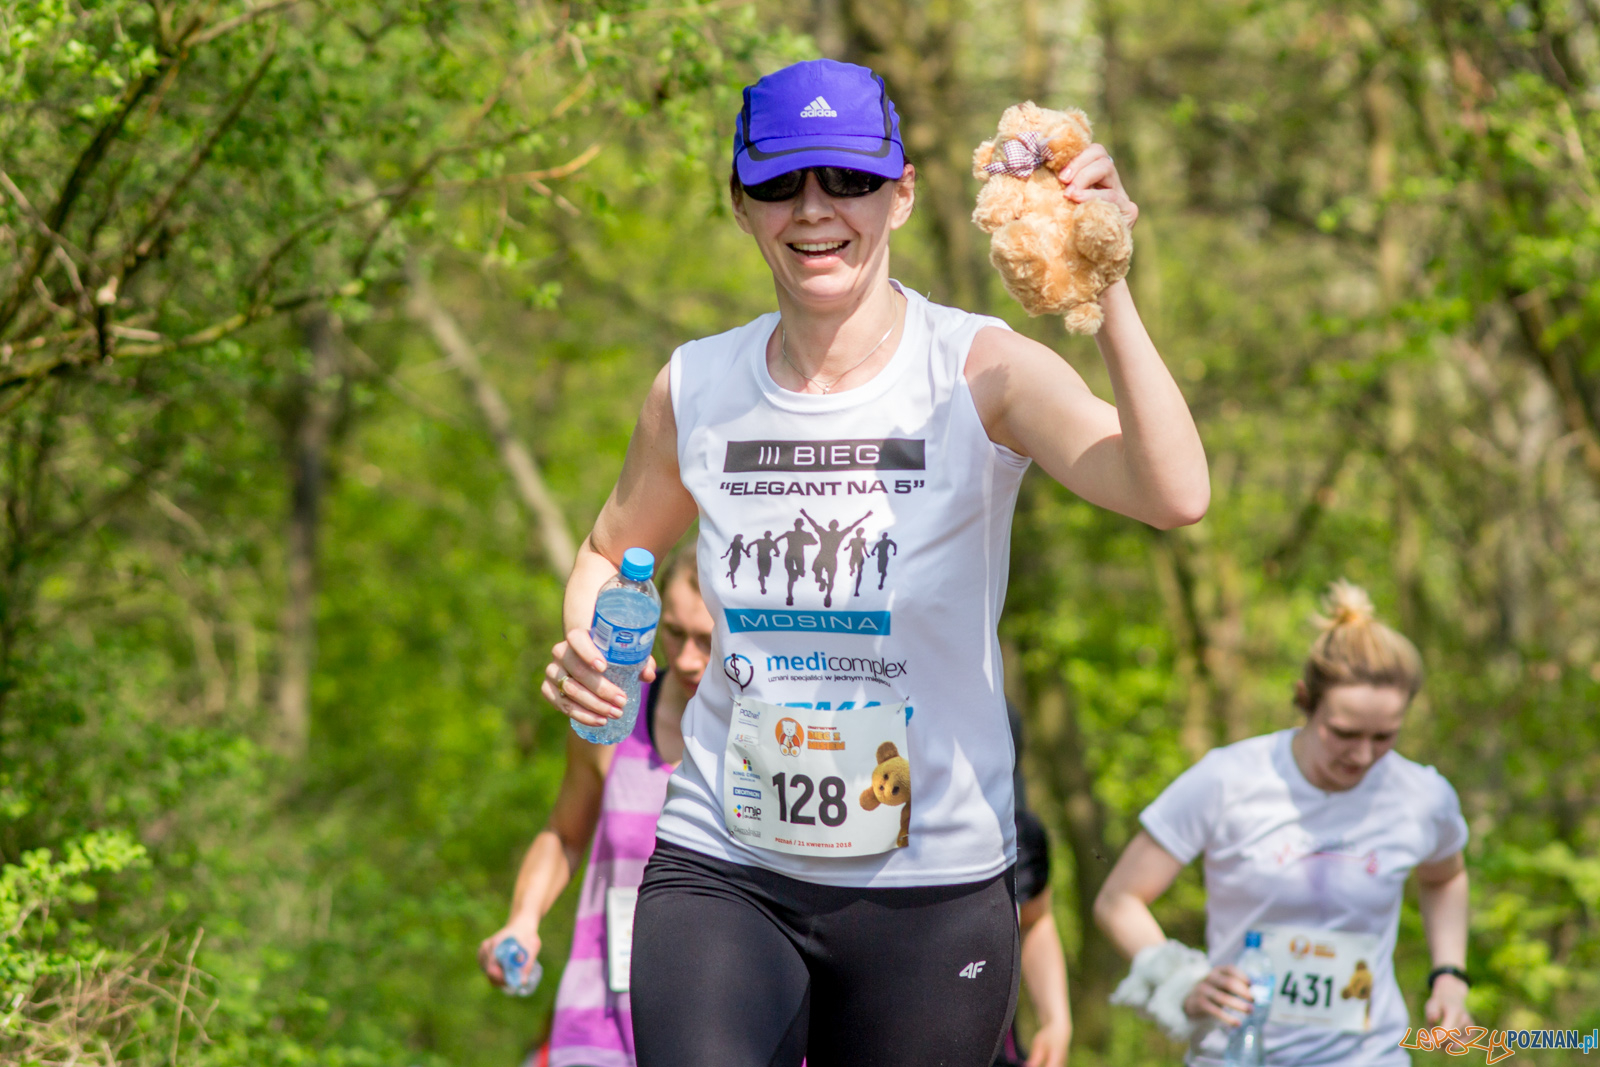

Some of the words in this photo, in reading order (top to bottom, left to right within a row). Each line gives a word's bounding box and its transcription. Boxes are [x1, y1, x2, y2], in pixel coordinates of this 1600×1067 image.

[800, 109, 838, 118] adidas
[793, 445, 880, 466] BIEG
[847, 480, 888, 495] NA
[739, 614, 879, 631] MOSINA
[766, 651, 908, 679] medicomplex
[768, 674, 789, 683] uznani
[834, 674, 864, 683] jednym
[772, 771, 848, 828] 128
[958, 960, 987, 979] 4F
[1279, 970, 1335, 1009] 431
